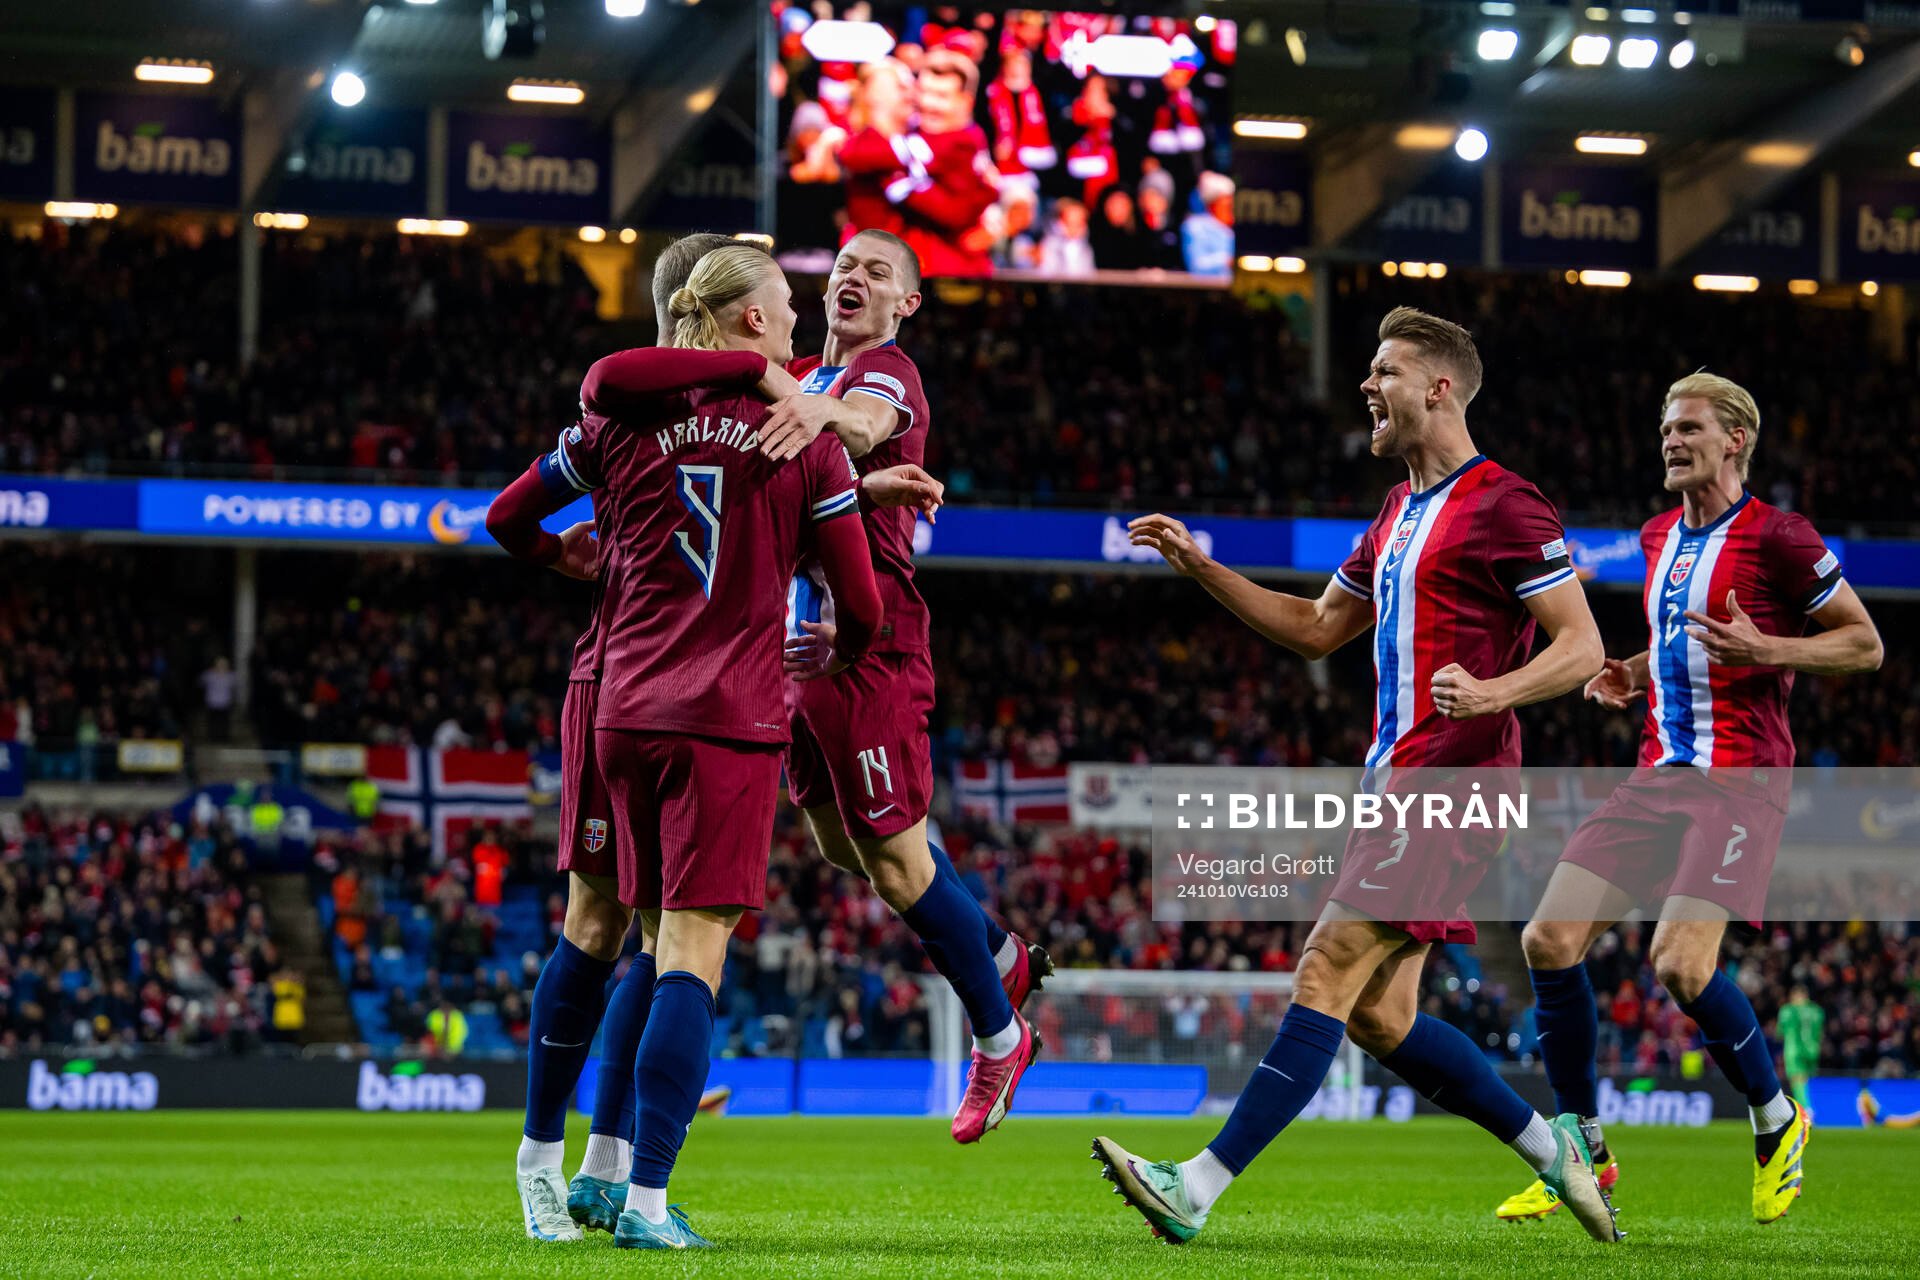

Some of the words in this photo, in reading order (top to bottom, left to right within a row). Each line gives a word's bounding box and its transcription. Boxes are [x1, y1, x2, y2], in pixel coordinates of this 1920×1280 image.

[96, 120, 231, 176] bama
[467, 142, 597, 195] bama
[1520, 190, 1641, 241] bama
[203, 493, 372, 529] POWERED
[380, 499, 420, 530] BY
[674, 464, 724, 601] 9
[1664, 602, 1682, 647] 2
[856, 746, 894, 799] 14
[1374, 826, 1410, 872] 3
[1722, 824, 1747, 867] 2
[27, 1058, 159, 1111] bama
[357, 1060, 486, 1112] bama
[1597, 1077, 1713, 1127] bama
